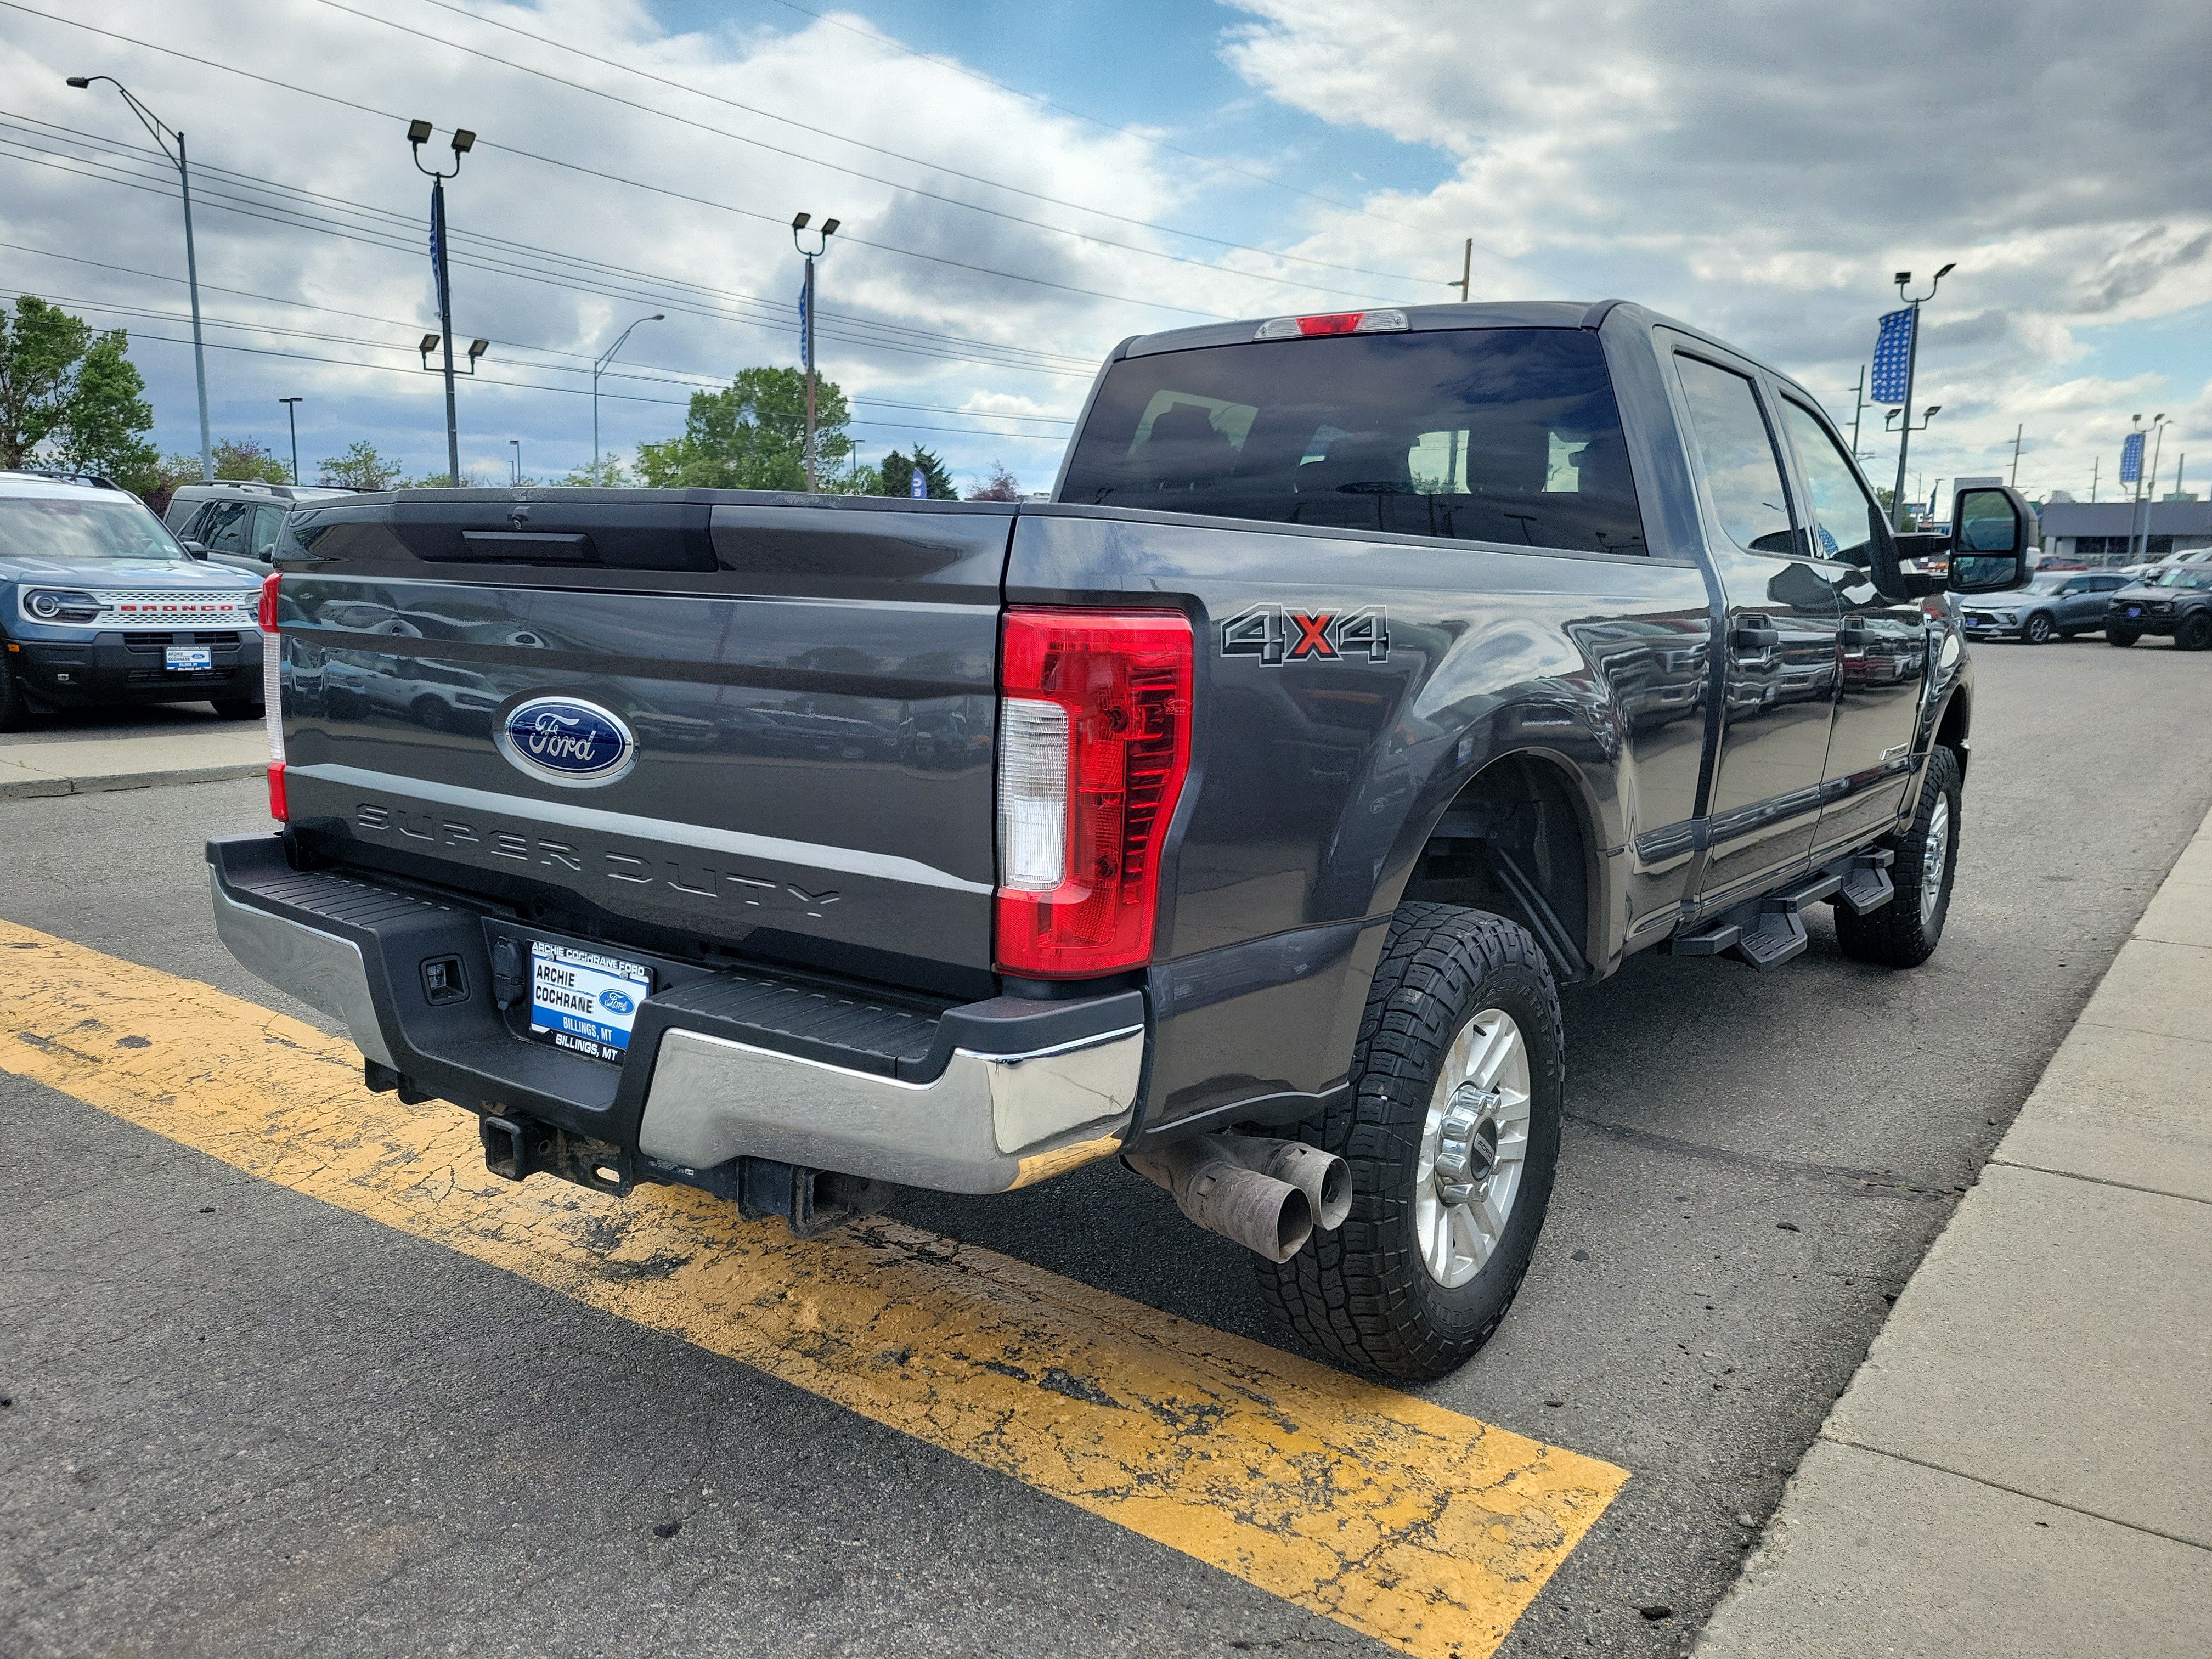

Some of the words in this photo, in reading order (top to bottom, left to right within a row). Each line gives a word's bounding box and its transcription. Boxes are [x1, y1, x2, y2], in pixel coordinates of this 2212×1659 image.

[529, 712, 596, 763] Ford
[357, 803, 582, 871] SUPER
[606, 851, 841, 918] DUTY
[532, 941, 565, 956] ARCHIE
[566, 949, 619, 969] COCHRANE
[618, 962, 645, 976] FORD
[536, 964, 575, 988] ARCHIE
[535, 985, 594, 1014] COCHRANE
[563, 1016, 599, 1040] BILLINGS,
[601, 1029, 613, 1042] MT
[555, 1034, 599, 1057] BILLINGS,
[602, 1048, 618, 1062] MT
[1477, 1139, 1493, 1159] FORD
